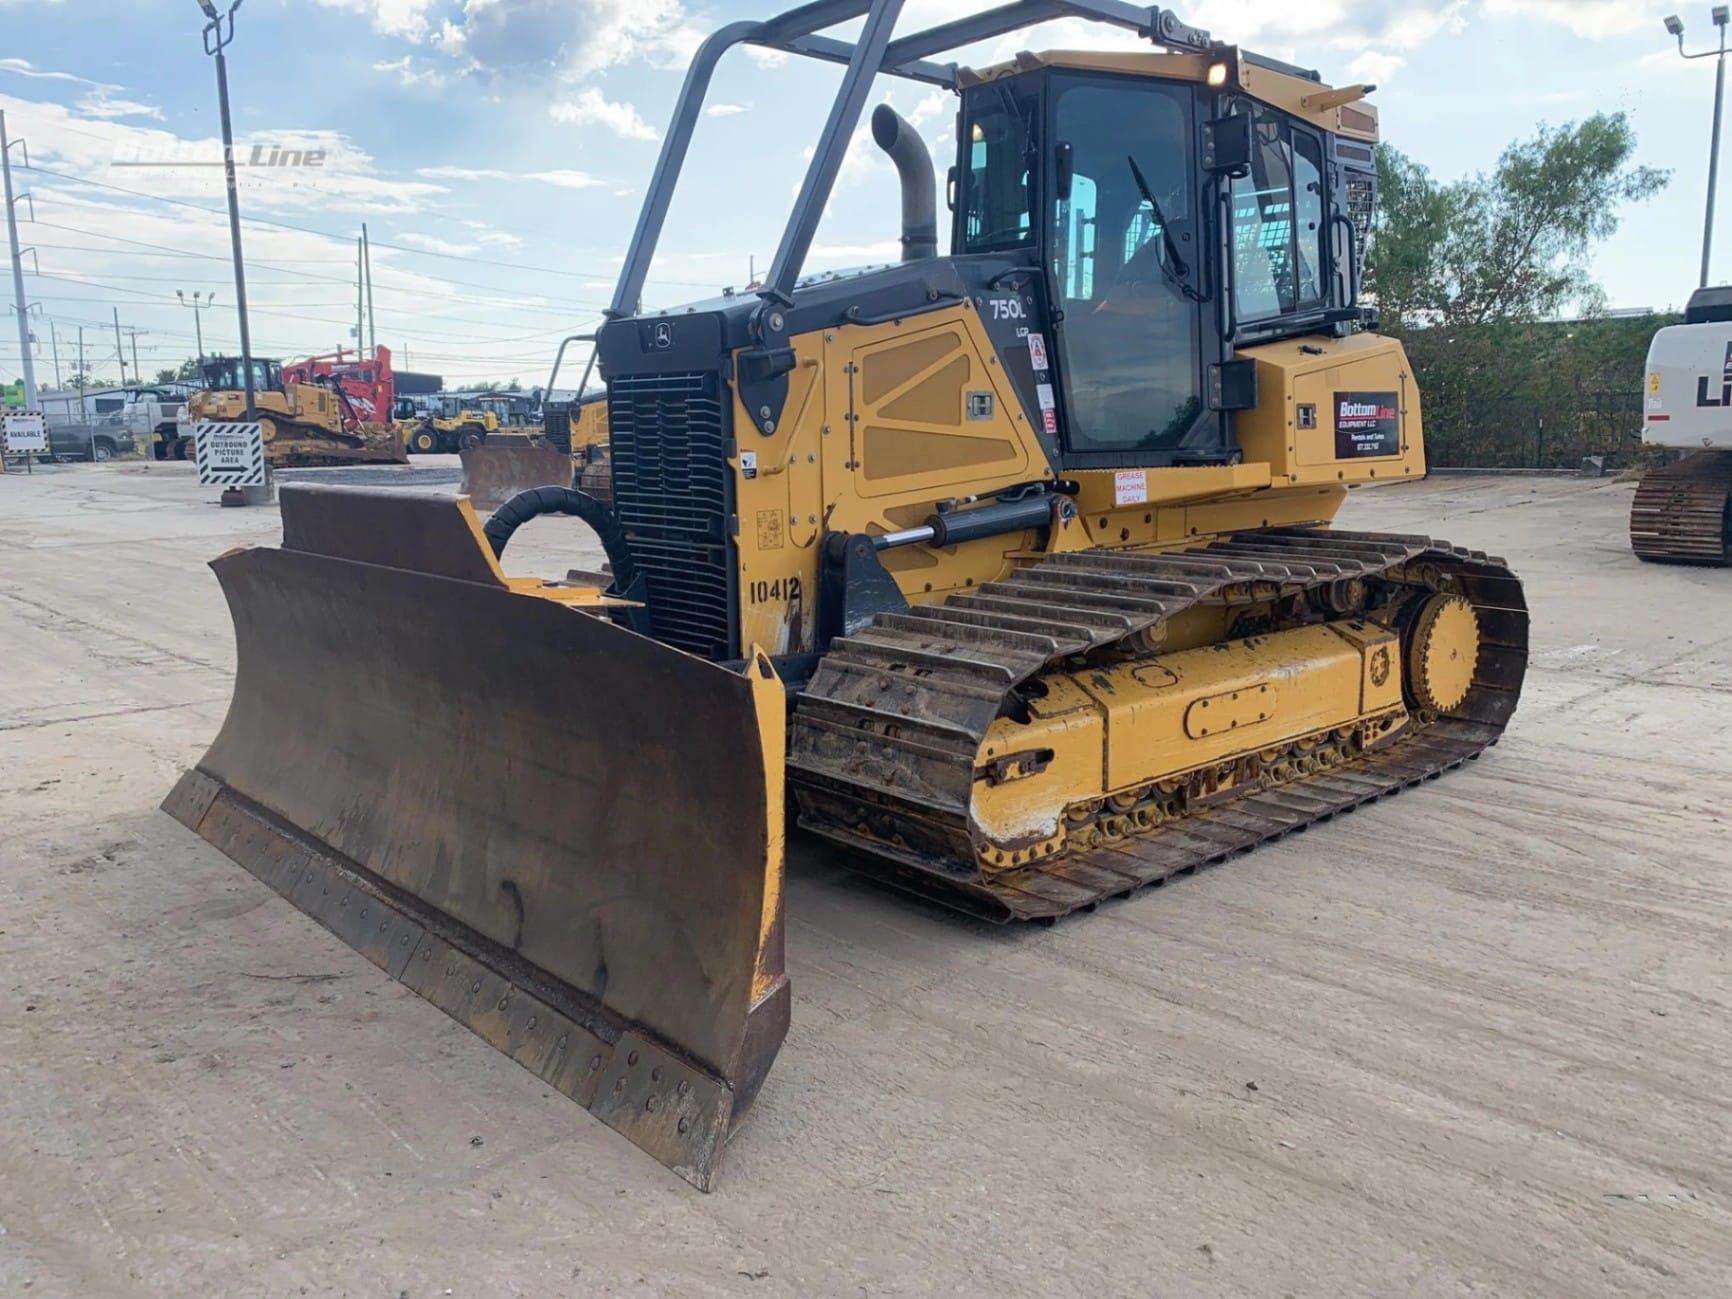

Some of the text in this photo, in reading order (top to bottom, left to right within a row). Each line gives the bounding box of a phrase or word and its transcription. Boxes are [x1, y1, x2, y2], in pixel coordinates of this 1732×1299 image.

[989, 299, 1027, 320] 750L
[210, 441, 248, 449] OUTBOUND
[221, 456, 239, 464] AREA
[1117, 472, 1144, 480] GREASE
[1117, 483, 1145, 491] MACHINE
[1122, 495, 1141, 503] DAILY
[750, 576, 800, 604] 10412
